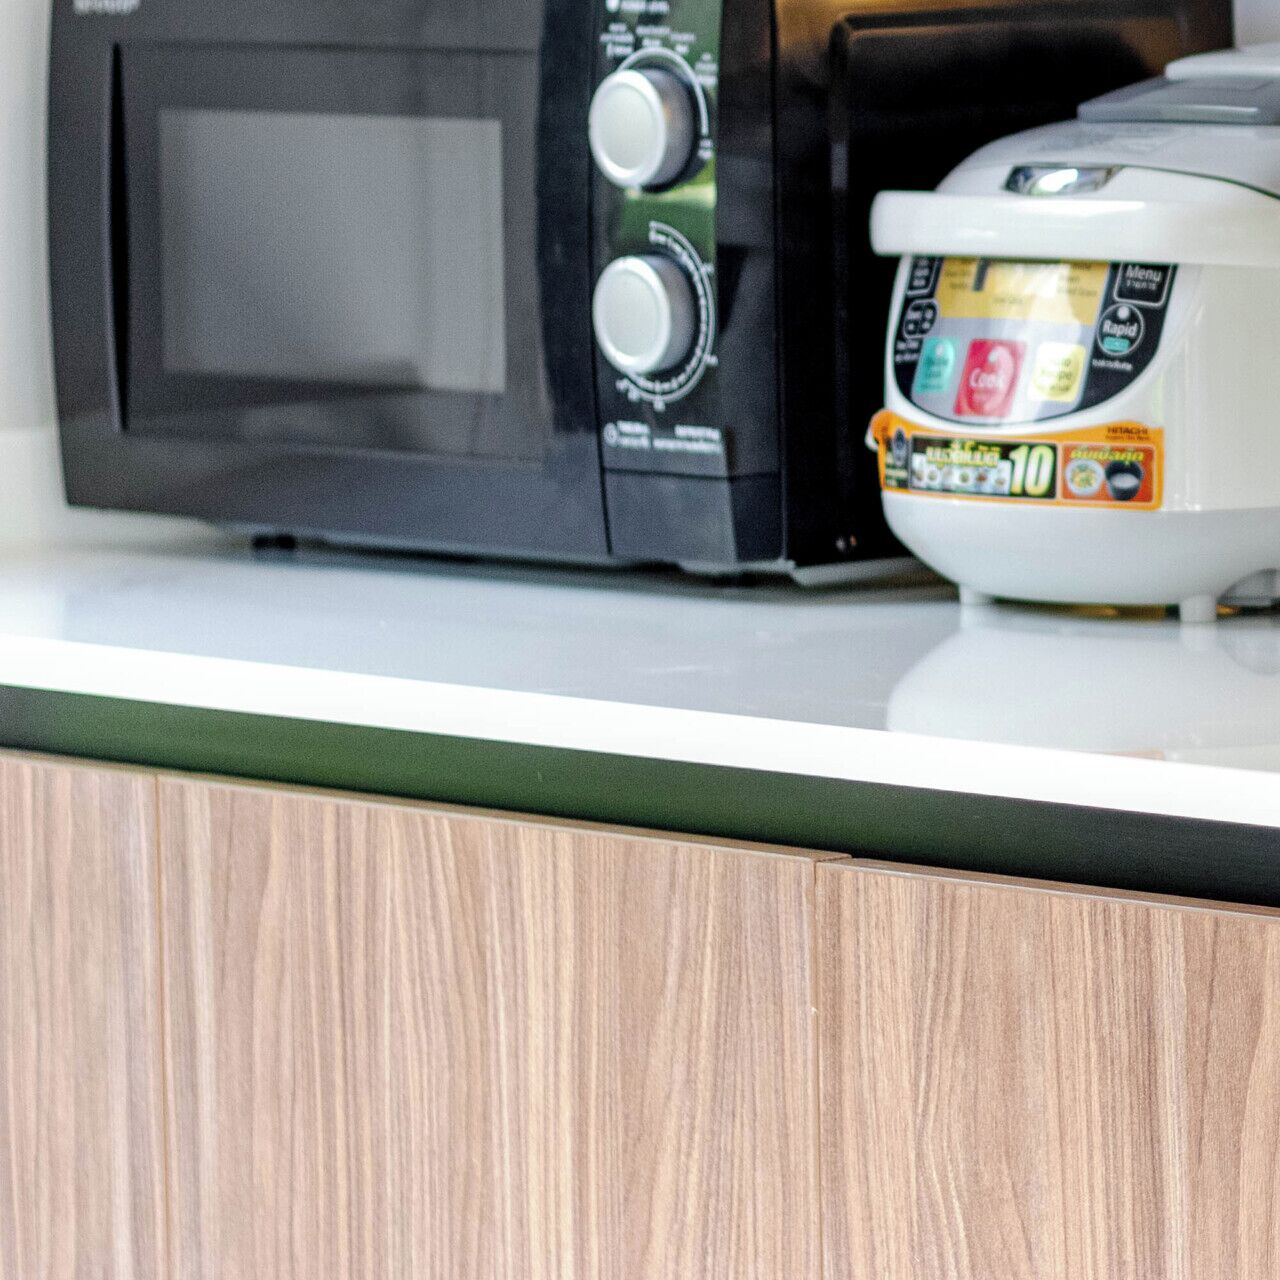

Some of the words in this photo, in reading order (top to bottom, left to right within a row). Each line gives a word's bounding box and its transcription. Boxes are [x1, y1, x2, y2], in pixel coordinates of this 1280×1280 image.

[1126, 265, 1162, 282] Menu
[1103, 319, 1138, 338] Rapid
[1009, 444, 1055, 497] 10
